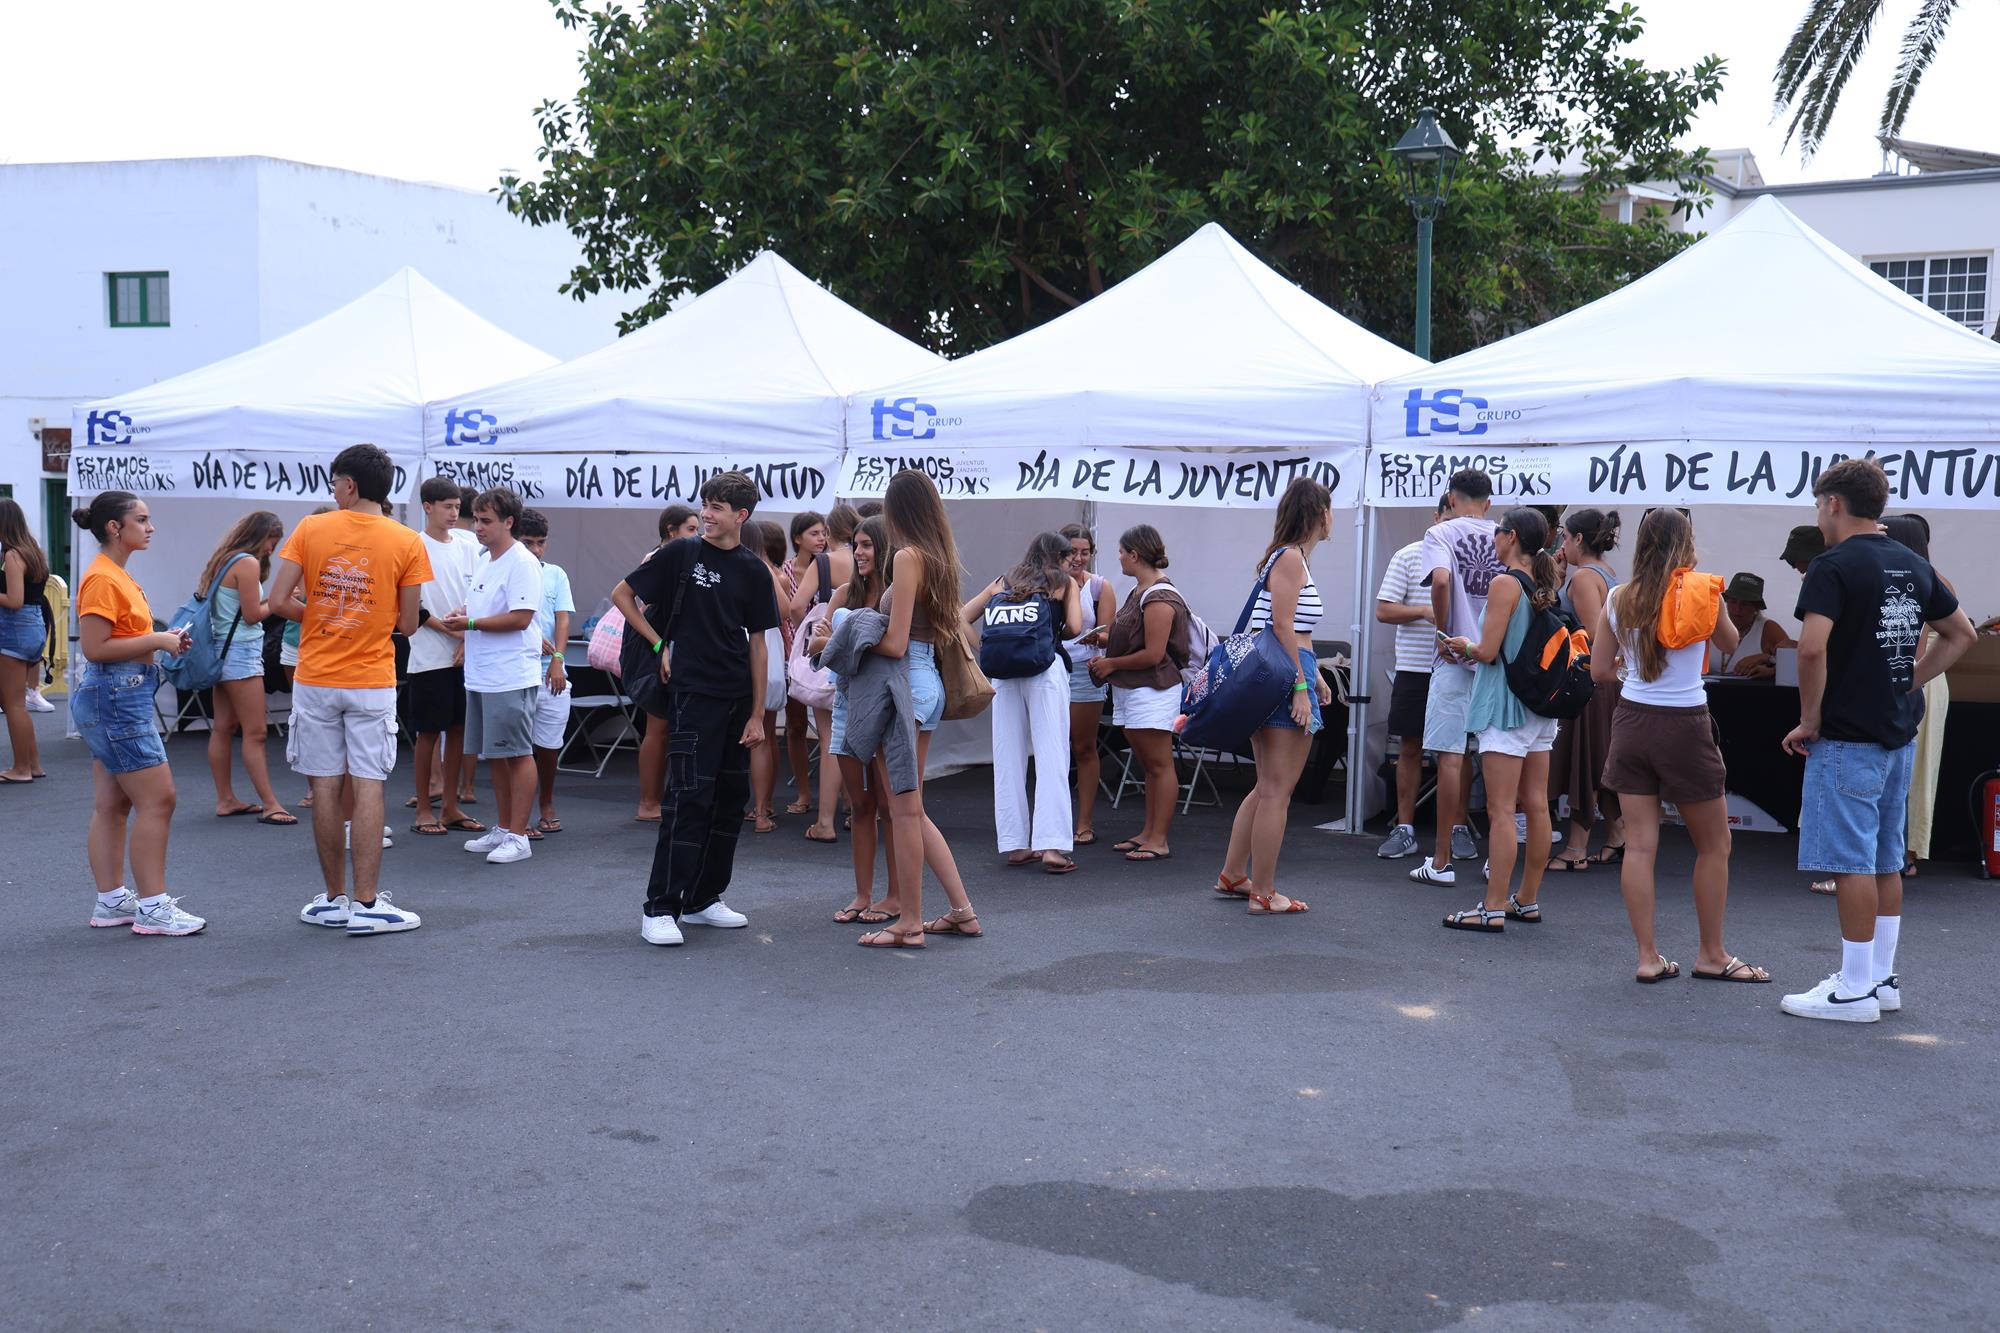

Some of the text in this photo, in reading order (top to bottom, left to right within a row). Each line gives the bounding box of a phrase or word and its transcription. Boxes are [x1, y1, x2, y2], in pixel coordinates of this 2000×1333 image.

[928, 416, 962, 427] GRUPO
[1477, 409, 1522, 421] GRUPO
[126, 425, 151, 434] GRUPO
[488, 427, 518, 436] GRUPO
[76, 456, 150, 475] ESTAMOS
[193, 452, 227, 490] DÍA
[232, 461, 257, 490] DE
[264, 462, 291, 492] LA
[434, 460, 514, 482] ESTAMOS
[858, 456, 954, 480] ESTAMOS
[1016, 450, 1060, 492] DÍA
[1072, 459, 1115, 492] DE
[1124, 459, 1162, 496] LA
[1380, 452, 1508, 477] ESTAMOS
[1588, 443, 1647, 495] DÍA
[1665, 452, 1713, 493] DE
[1727, 451, 1776, 495] LA
[566, 457, 603, 500] DÍA
[613, 467, 642, 498] DE
[652, 465, 681, 501] LA
[985, 602, 1039, 626] VANS
